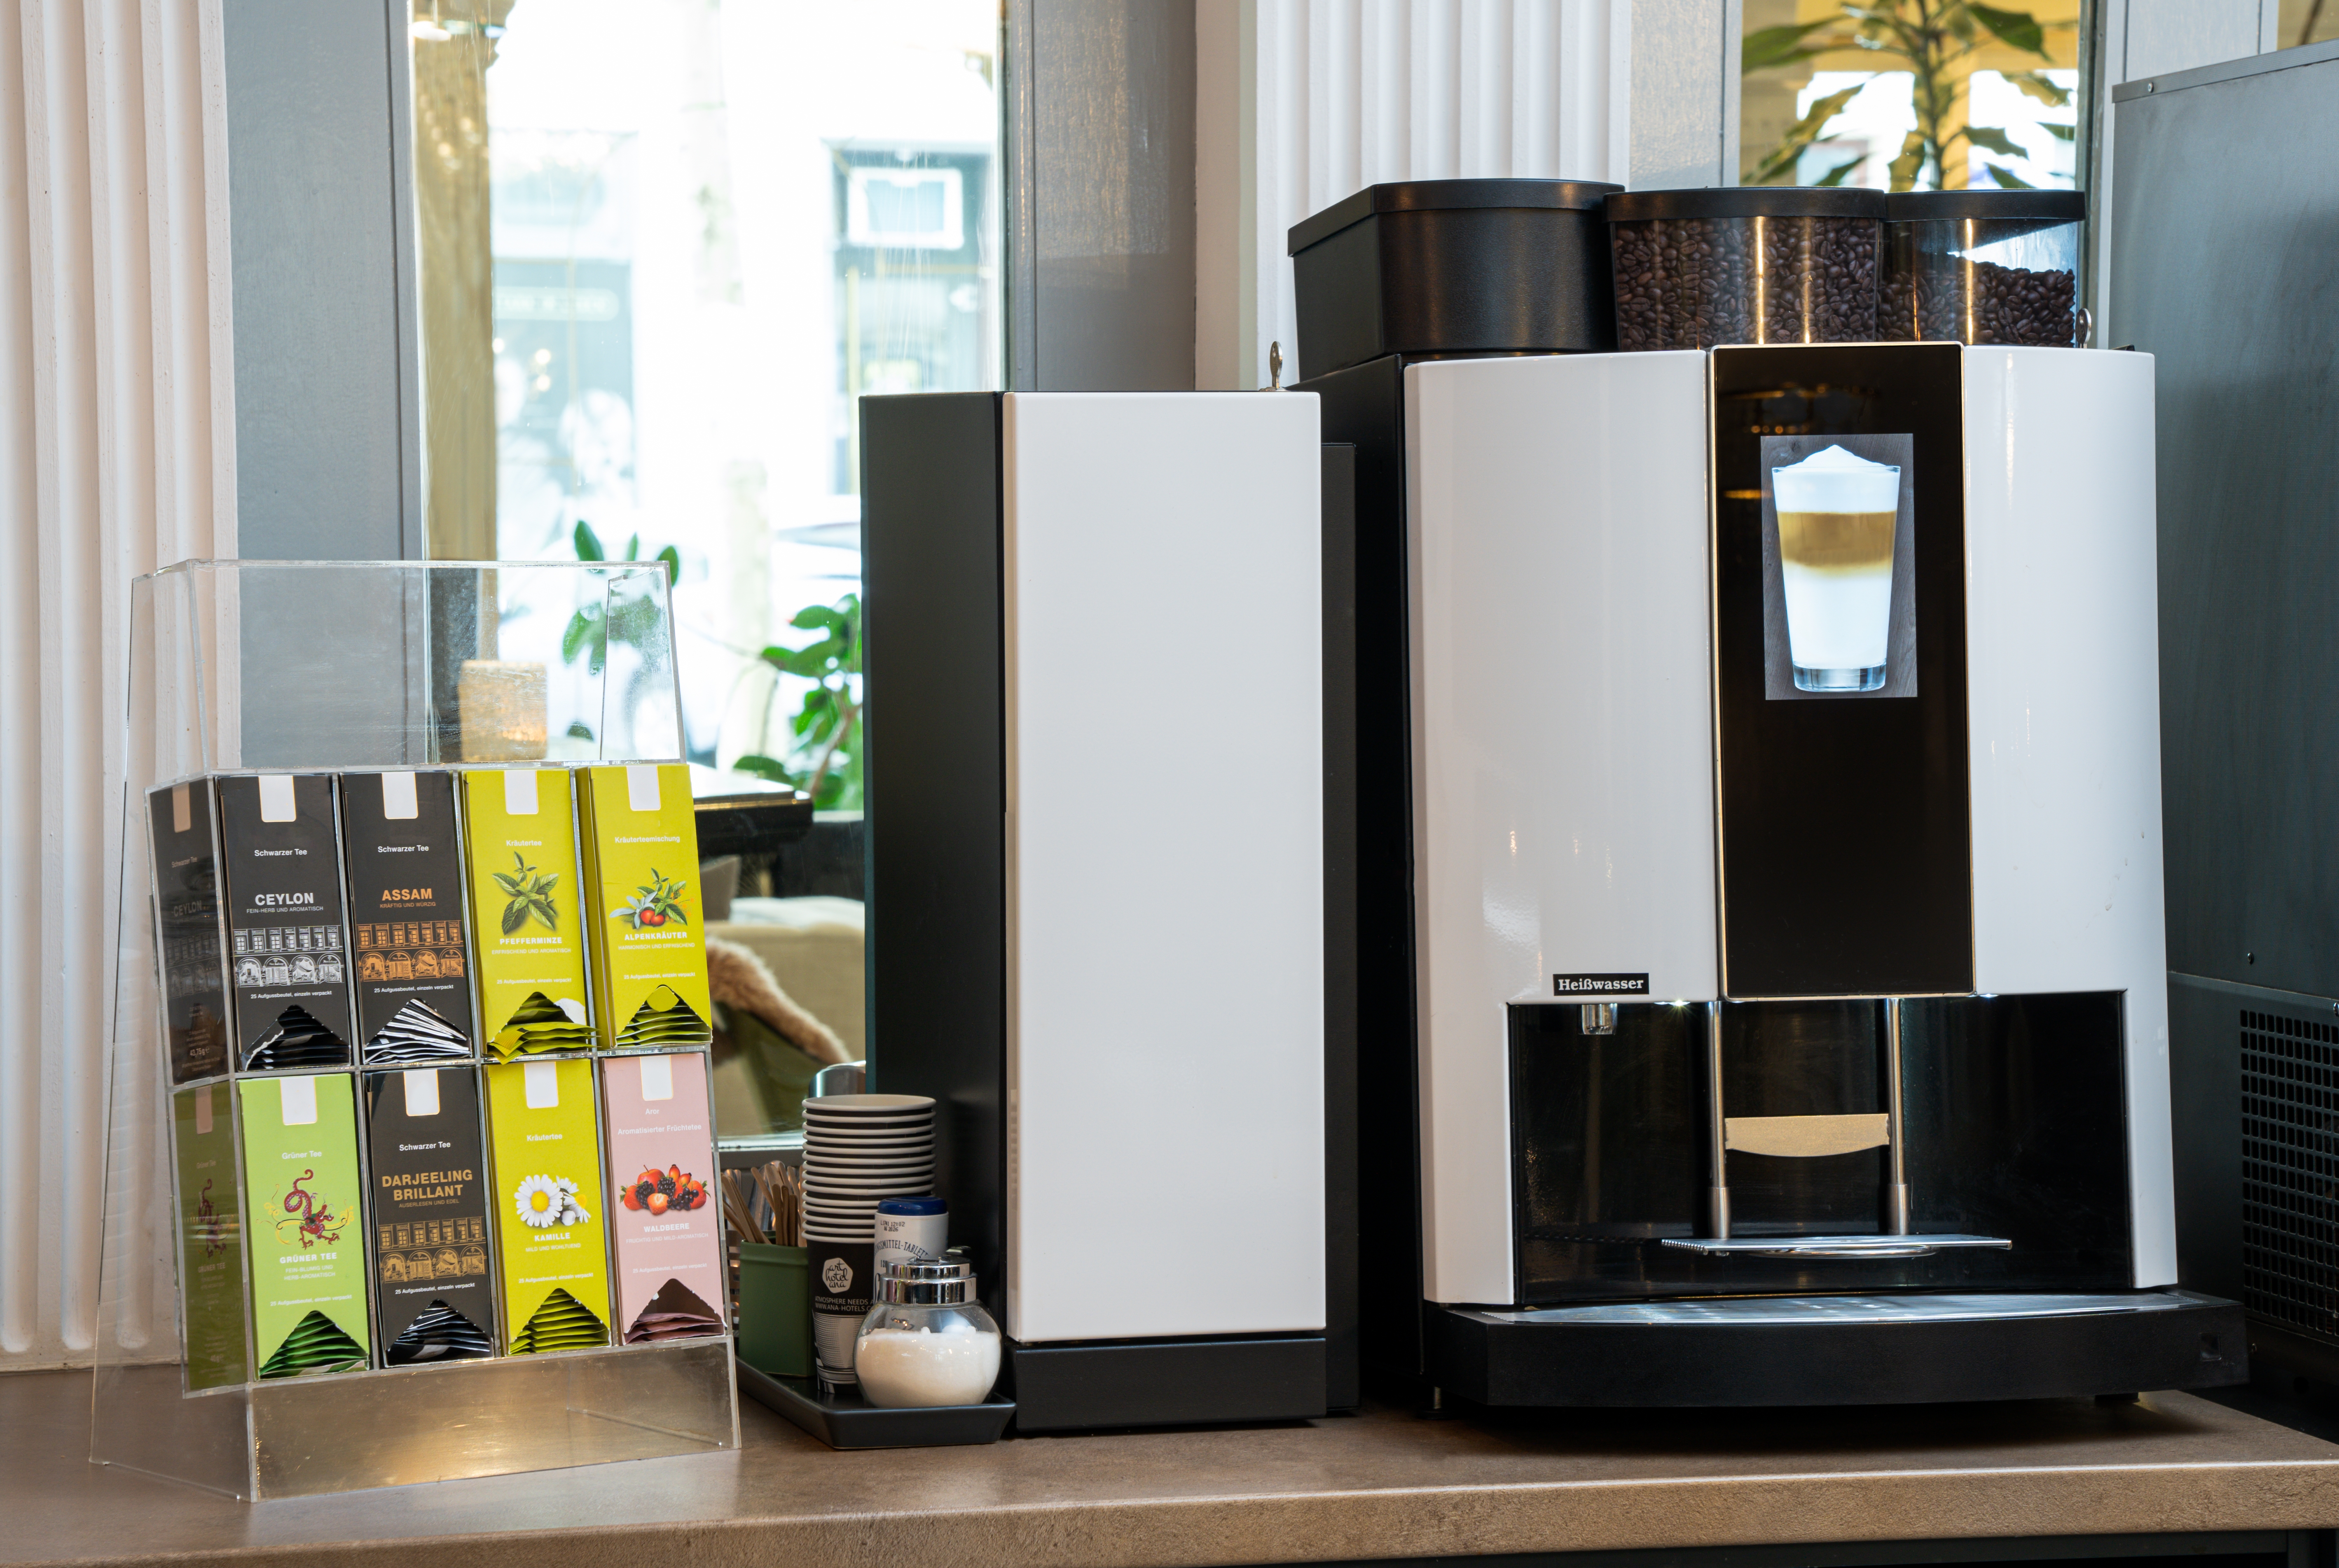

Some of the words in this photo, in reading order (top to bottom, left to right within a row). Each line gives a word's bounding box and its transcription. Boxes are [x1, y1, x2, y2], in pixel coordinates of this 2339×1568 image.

[615, 835, 680, 844] Kräuterteemischung
[255, 893, 313, 905] CEYLON
[382, 889, 432, 900] ASSAM
[625, 931, 687, 940] ALPENKRÄUTER
[1558, 979, 1644, 991] Heißwasser
[617, 1126, 665, 1135] Aromatisierter
[667, 1124, 702, 1132] Früchtetee
[399, 1143, 436, 1151] Schwarzer
[382, 1169, 472, 1187] DARJEELING
[393, 1185, 463, 1201] BRILLANT
[644, 1223, 690, 1232] WALDBEERE
[535, 1232, 570, 1241] KAMILLE
[280, 1253, 317, 1264] GRÜNER
[829, 1260, 844, 1271] art
[284, 1272, 335, 1281] HERB-AROMATISCH
[826, 1268, 848, 1281] hotel
[402, 1286, 436, 1294] Aufgussbeutel,
[278, 1298, 313, 1306] Aufgussbeutel,
[815, 1303, 871, 1311] WWW.ANA-HOTELS.C
